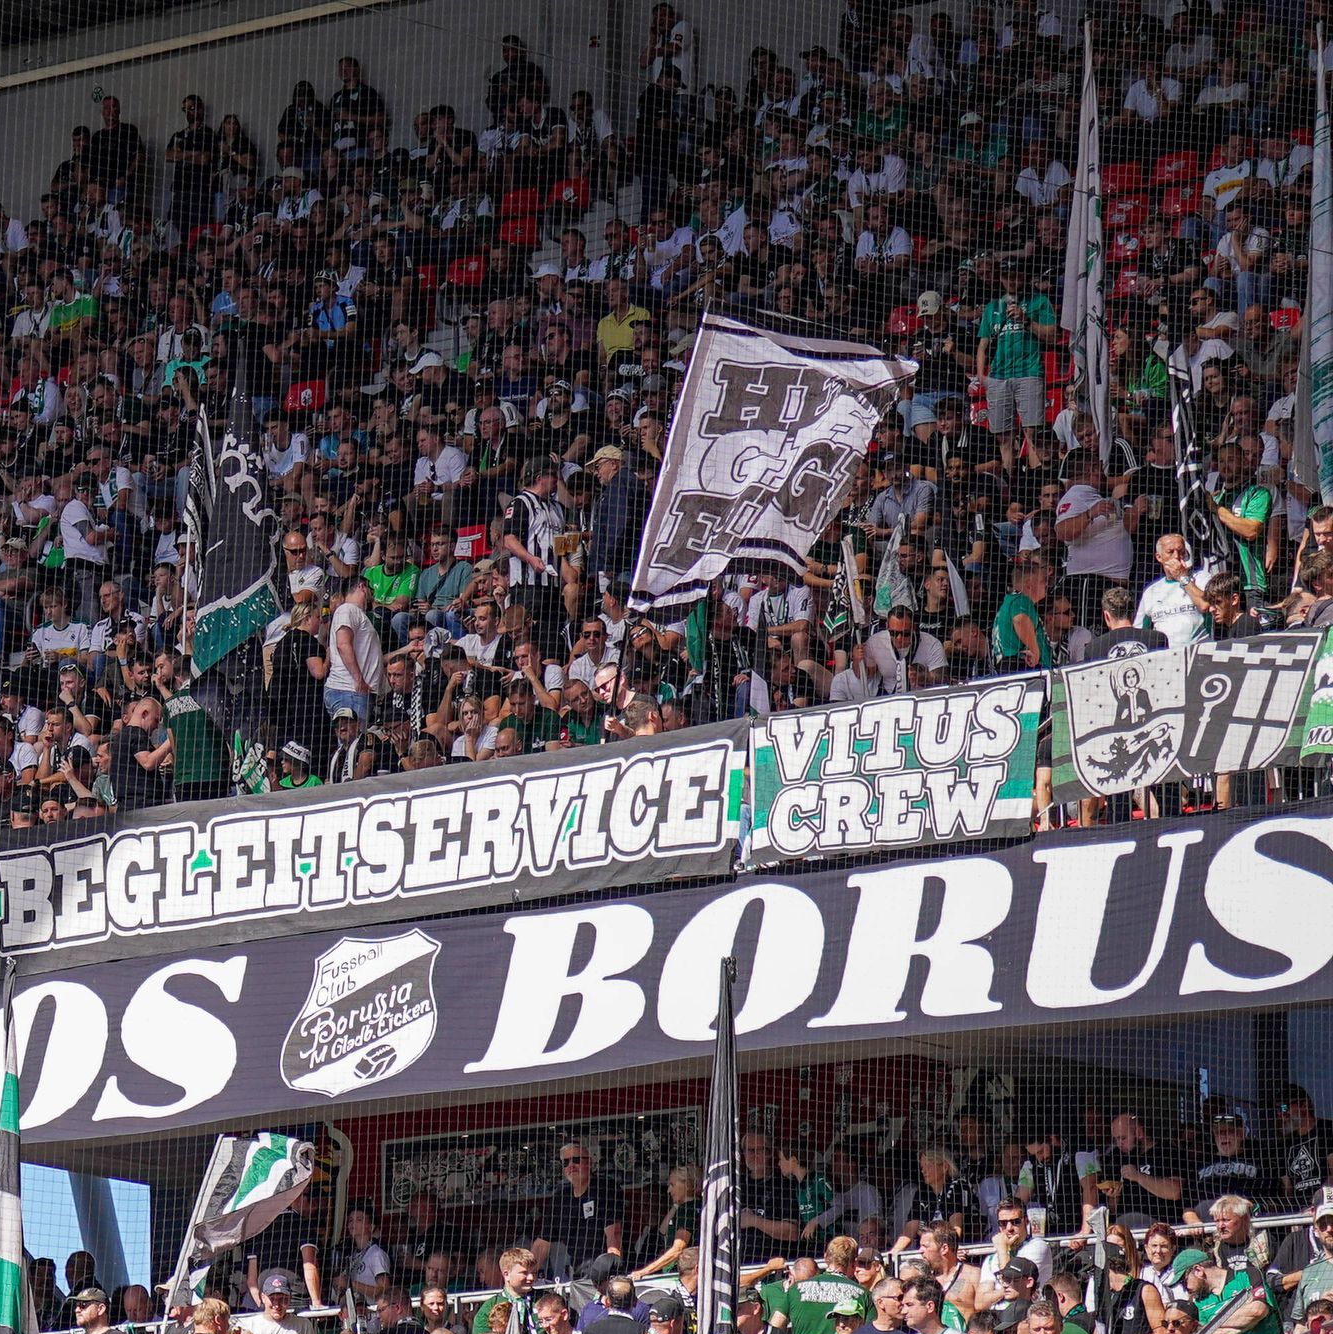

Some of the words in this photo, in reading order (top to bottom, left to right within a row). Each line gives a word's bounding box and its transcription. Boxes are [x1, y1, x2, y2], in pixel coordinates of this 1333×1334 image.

[770, 683, 1027, 787] VITUS
[766, 763, 1009, 858] CREW
[315, 974, 357, 1008] Club
[320, 942, 384, 985] Fussball
